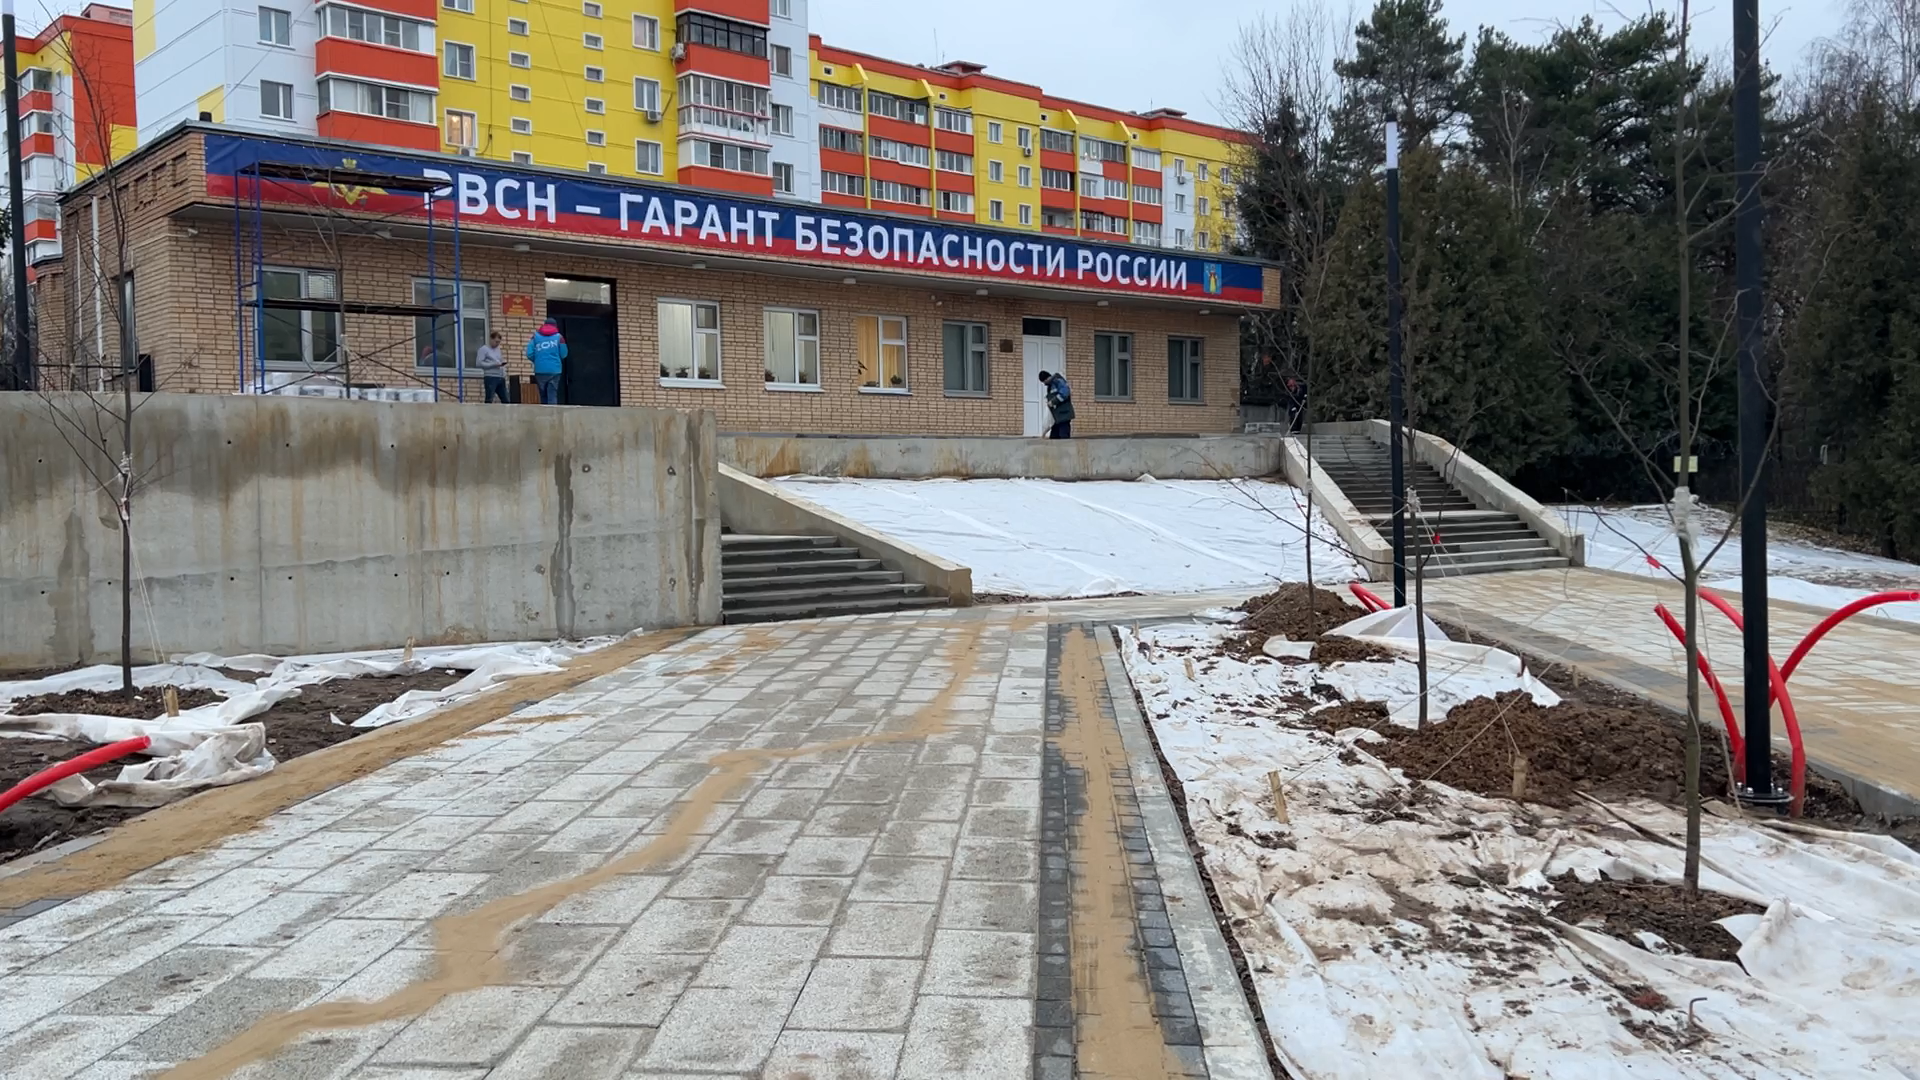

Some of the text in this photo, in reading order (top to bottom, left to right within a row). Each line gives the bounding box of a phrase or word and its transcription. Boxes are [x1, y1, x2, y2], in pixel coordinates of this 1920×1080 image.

[619, 192, 779, 248] ГАРАНТ
[795, 215, 1065, 278] БЕЗОПАСНОСТИ
[1077, 249, 1187, 291] РОССИИ
